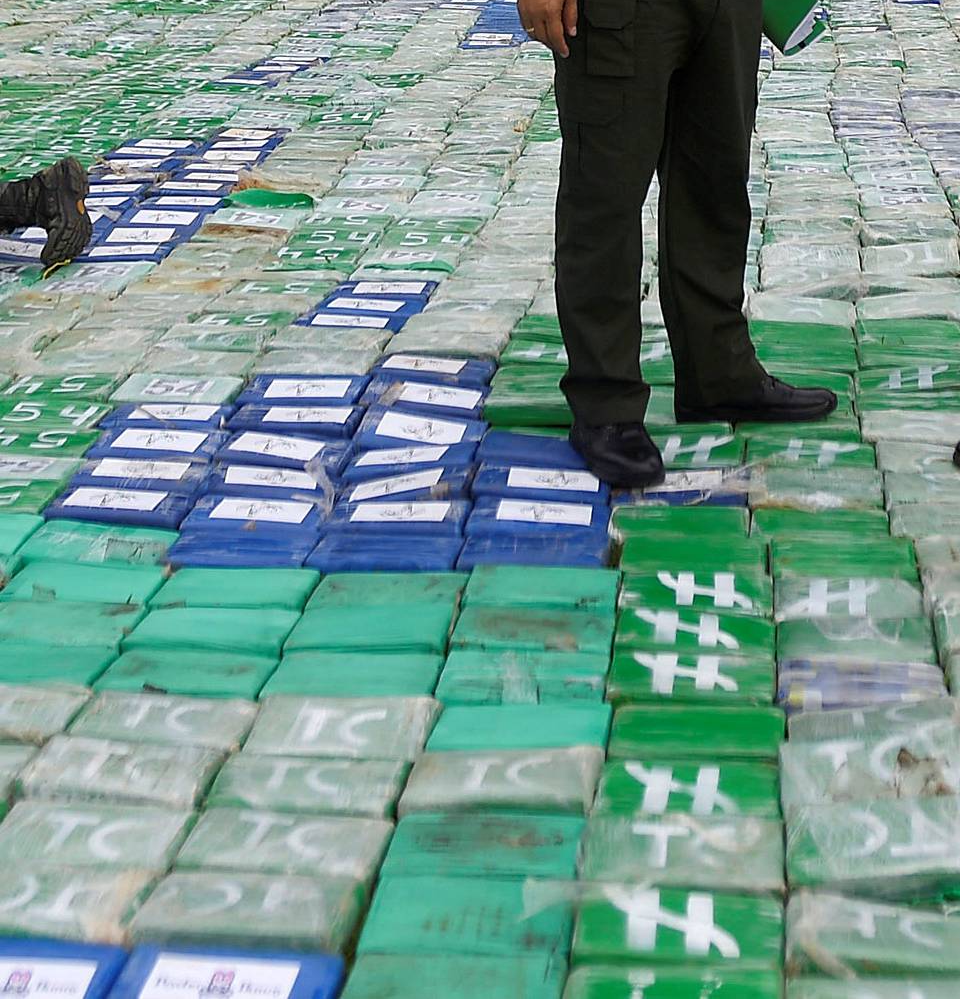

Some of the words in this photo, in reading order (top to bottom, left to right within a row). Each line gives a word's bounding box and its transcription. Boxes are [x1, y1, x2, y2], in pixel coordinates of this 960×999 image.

[307, 230, 376, 245] 54
[400, 233, 471, 246] 54
[2, 402, 99, 426] 54
